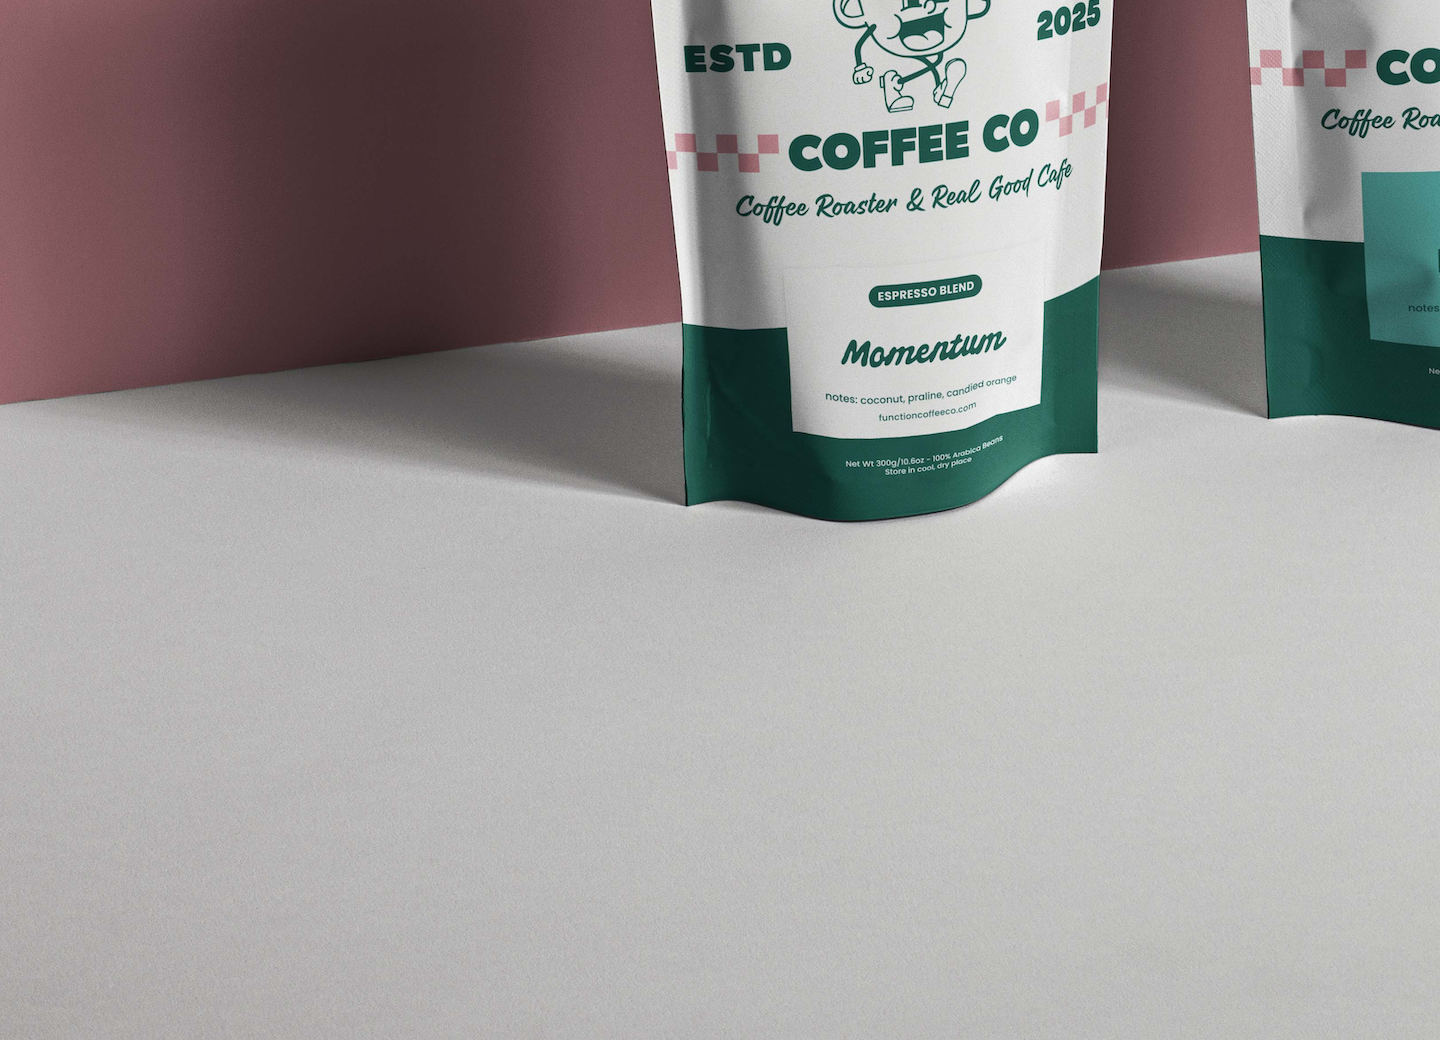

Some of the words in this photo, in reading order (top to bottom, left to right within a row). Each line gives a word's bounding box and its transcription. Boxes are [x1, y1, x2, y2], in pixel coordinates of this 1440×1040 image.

[684, 42, 792, 73] ESTD
[1320, 109, 1396, 138] Coffee
[788, 121, 969, 172] COFFEE
[982, 108, 1039, 152] CO
[735, 195, 809, 226] Coffee
[816, 193, 898, 218] Roaster
[906, 188, 925, 212] &
[931, 181, 981, 209] Real
[989, 169, 1033, 200] Good
[1037, 158, 1073, 190] Cafe
[878, 287, 937, 301] ESPRESSO
[940, 281, 974, 295] BLEND
[841, 331, 1007, 368] Momentum
[826, 393, 858, 404] notes:
[860, 395, 905, 405] coconut,
[908, 391, 944, 404] praline,
[947, 380, 984, 398] candied
[986, 375, 1017, 387] orange
[879, 402, 976, 422] functioncoffeeco.com
[933, 453, 951, 462] 100%
[952, 445, 981, 458] Arabica
[982, 435, 1003, 449] Beans
[917, 464, 935, 472] cool,
[937, 461, 950, 471] dry
[951, 456, 972, 467] place
